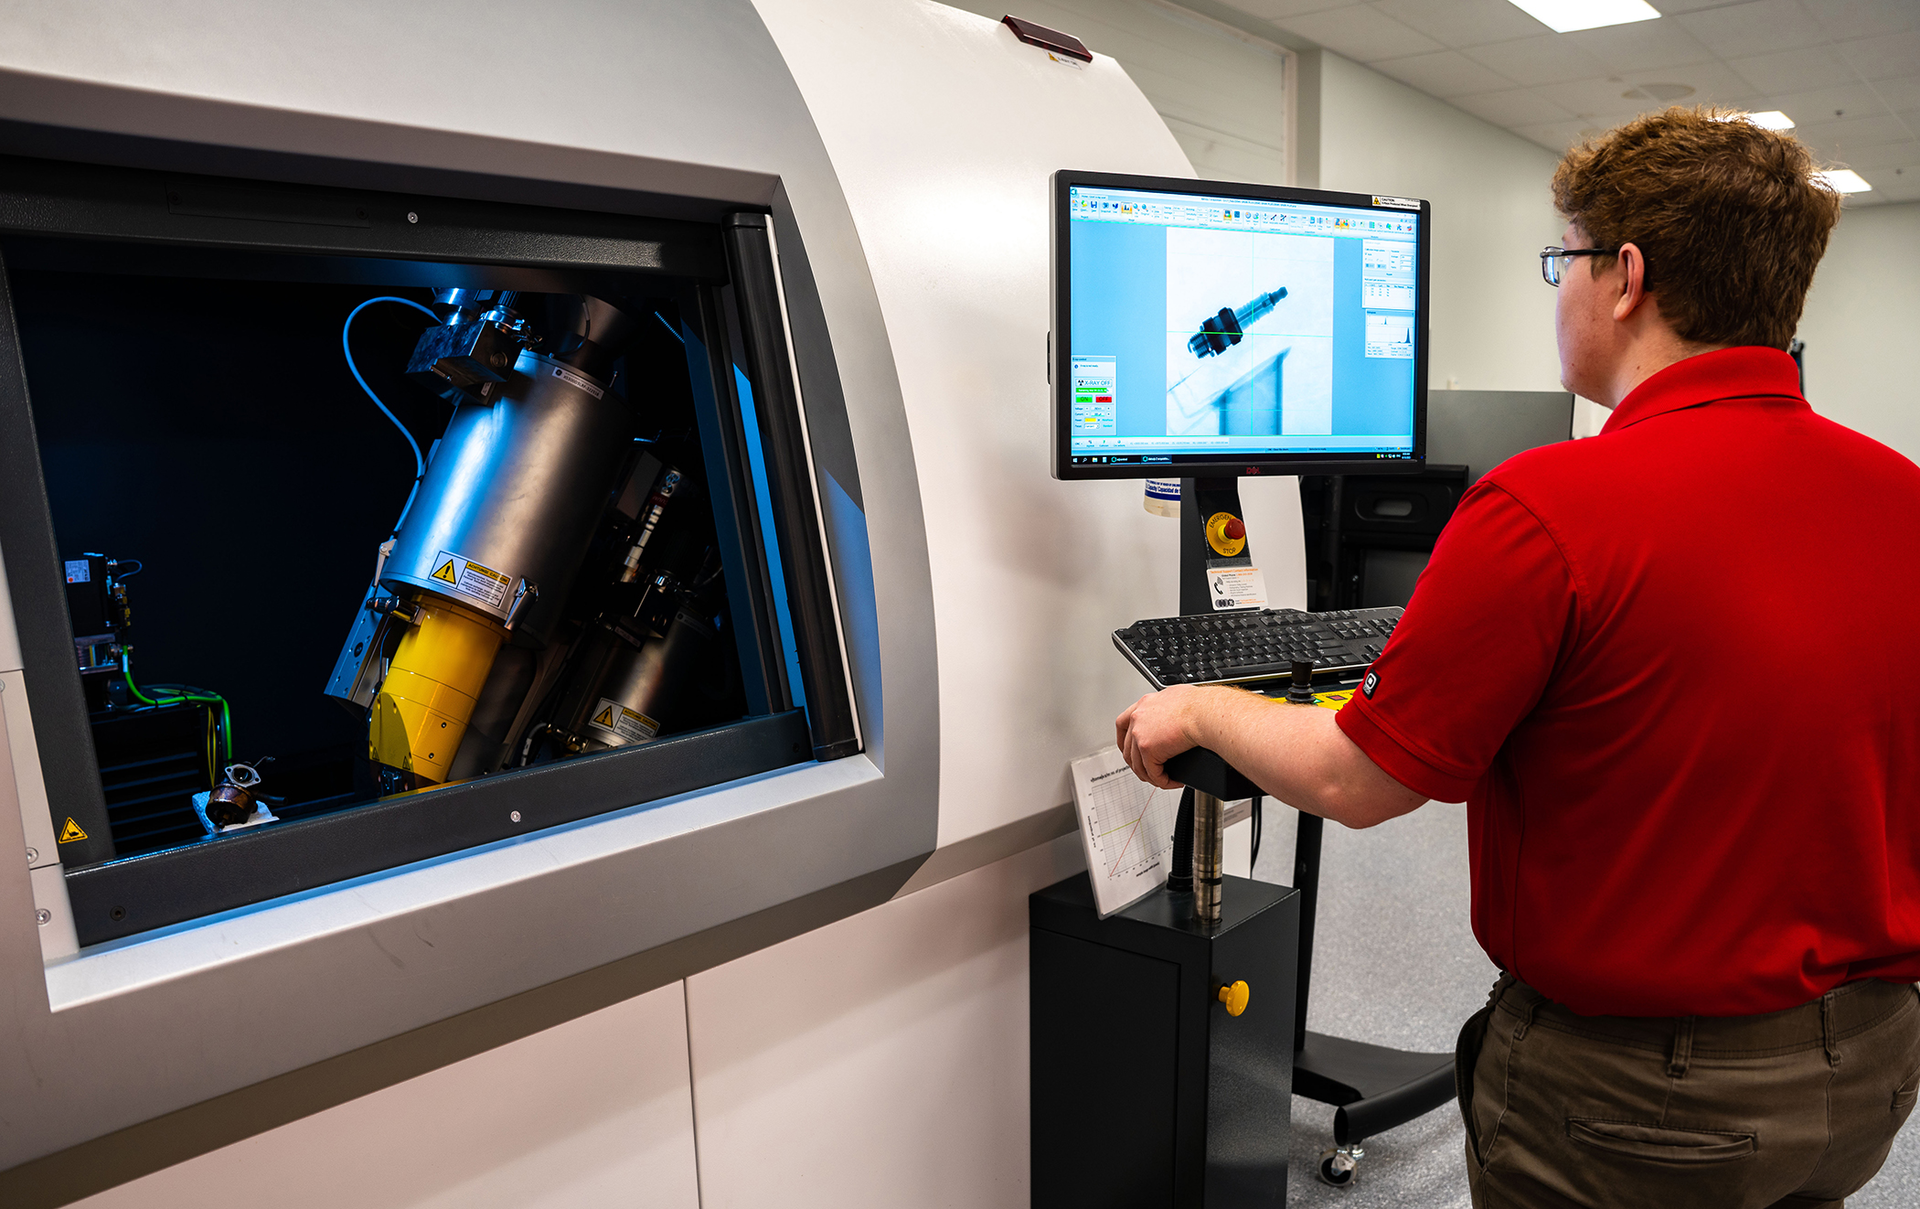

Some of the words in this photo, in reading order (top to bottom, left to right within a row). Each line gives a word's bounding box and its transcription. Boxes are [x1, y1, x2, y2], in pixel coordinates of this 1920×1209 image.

[1209, 513, 1232, 529] EMERGEN
[1223, 547, 1237, 555] STOP
[489, 571, 508, 583] CAUION
